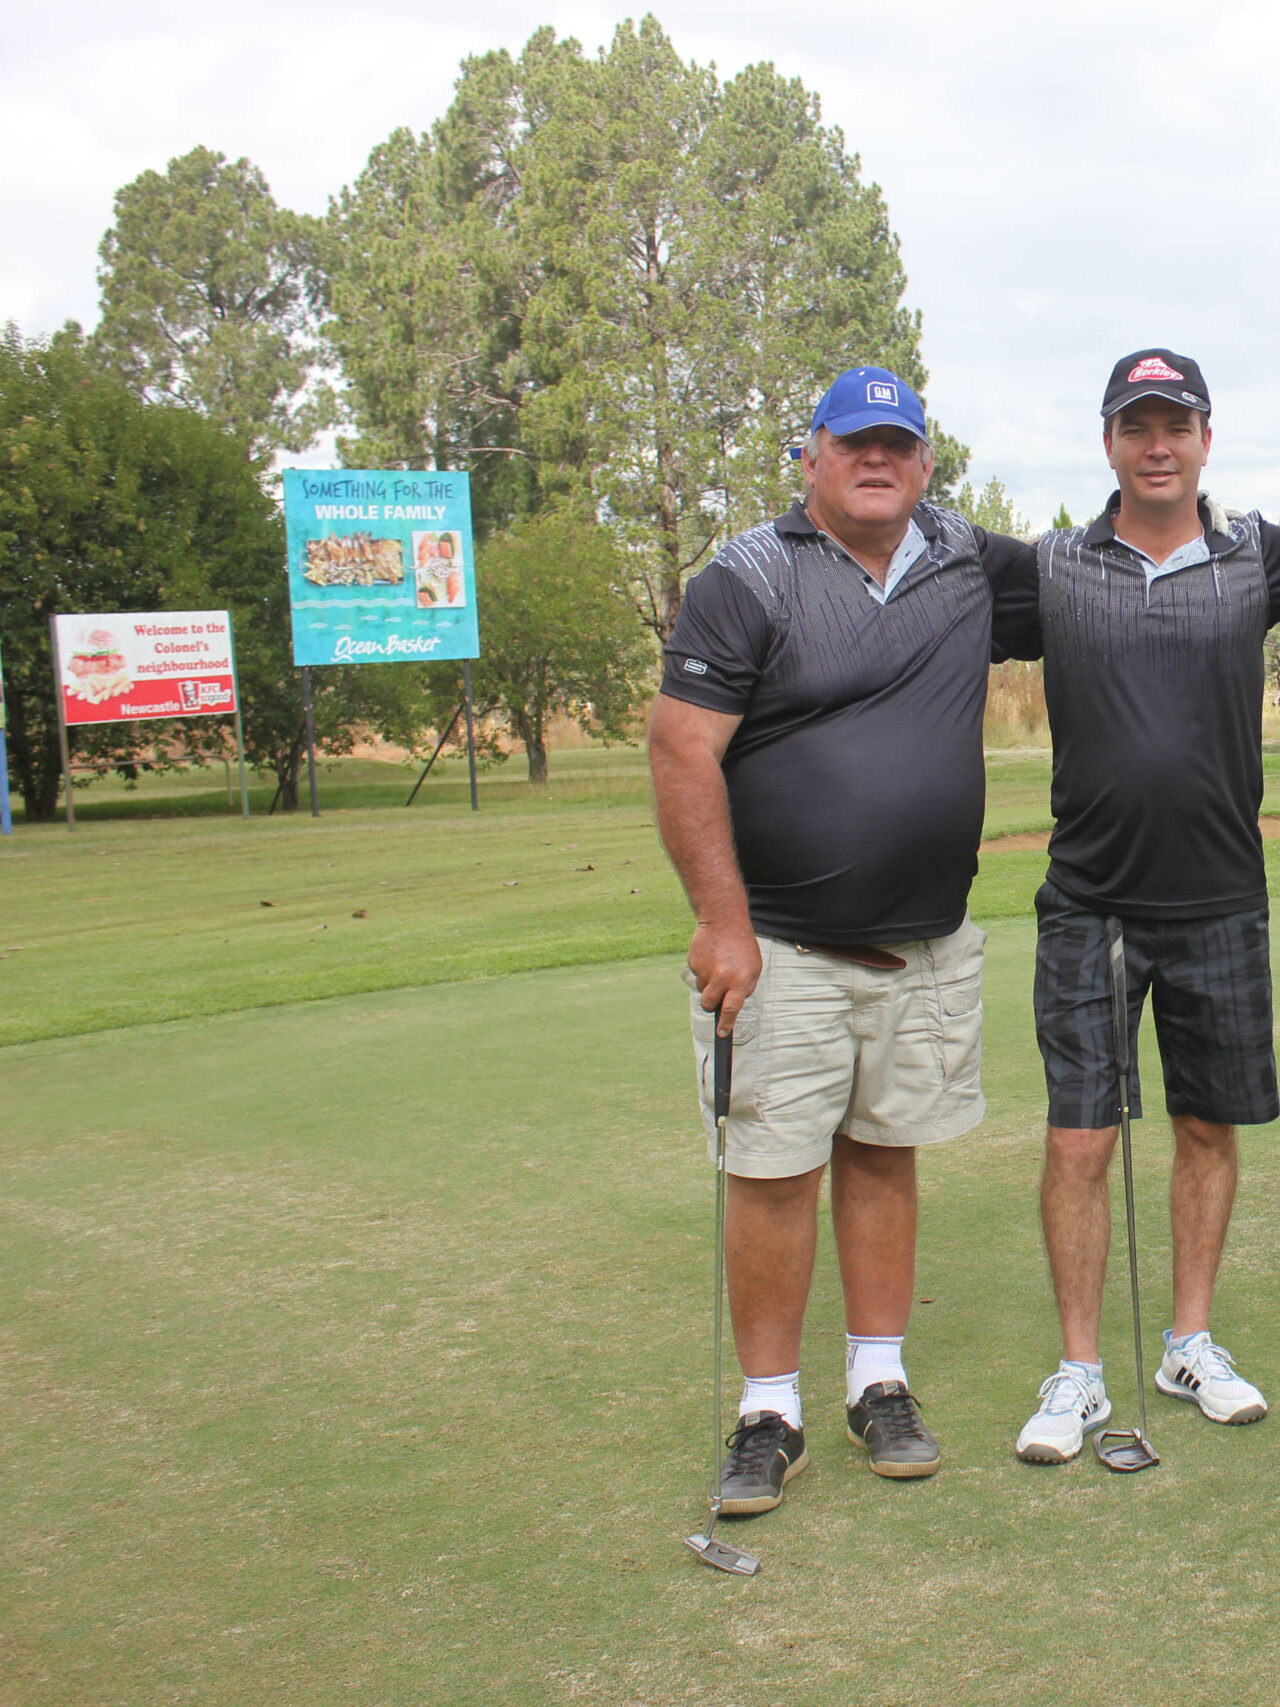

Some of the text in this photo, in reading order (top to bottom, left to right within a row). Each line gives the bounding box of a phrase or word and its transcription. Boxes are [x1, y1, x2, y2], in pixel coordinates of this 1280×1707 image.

[873, 386, 892, 400] GM
[302, 479, 454, 500] SOMETHING FOR THE
[314, 504, 446, 520] WHOLE FAMILY
[133, 622, 226, 637] Welcome to the
[154, 641, 210, 654] Colonel's
[333, 634, 441, 659] Ocean Basket
[137, 658, 229, 675] neighbourhood
[120, 701, 180, 715] Newcastle
